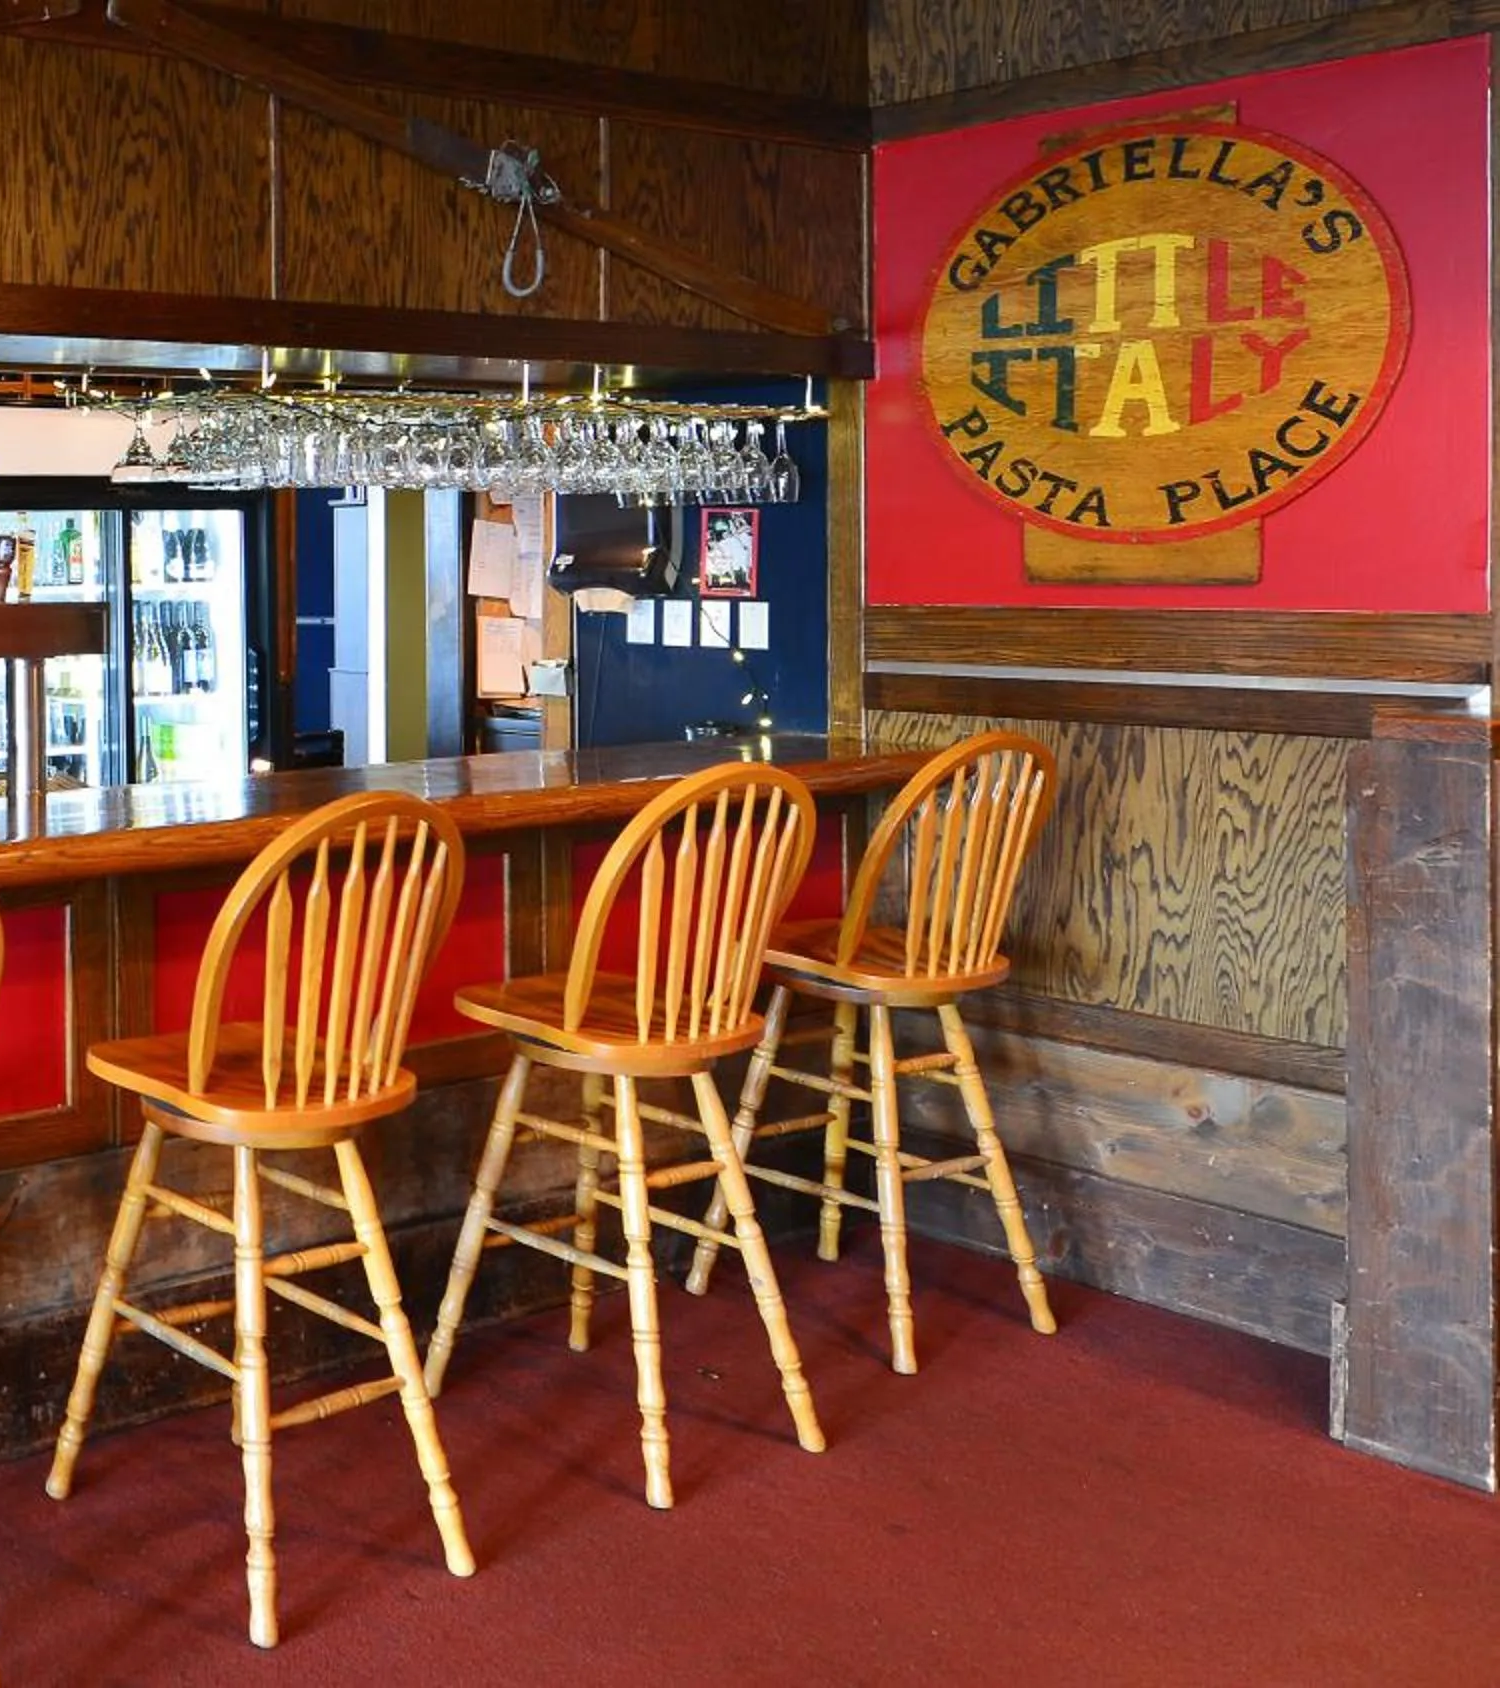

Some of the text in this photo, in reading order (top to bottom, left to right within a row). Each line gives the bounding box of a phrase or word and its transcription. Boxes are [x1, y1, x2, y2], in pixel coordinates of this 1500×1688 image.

[948, 137, 1363, 292] GABRIELLA'S
[981, 233, 1310, 339] LITTLE
[970, 328, 1311, 438] ITALY
[941, 379, 1361, 527] PASTA PLACE
